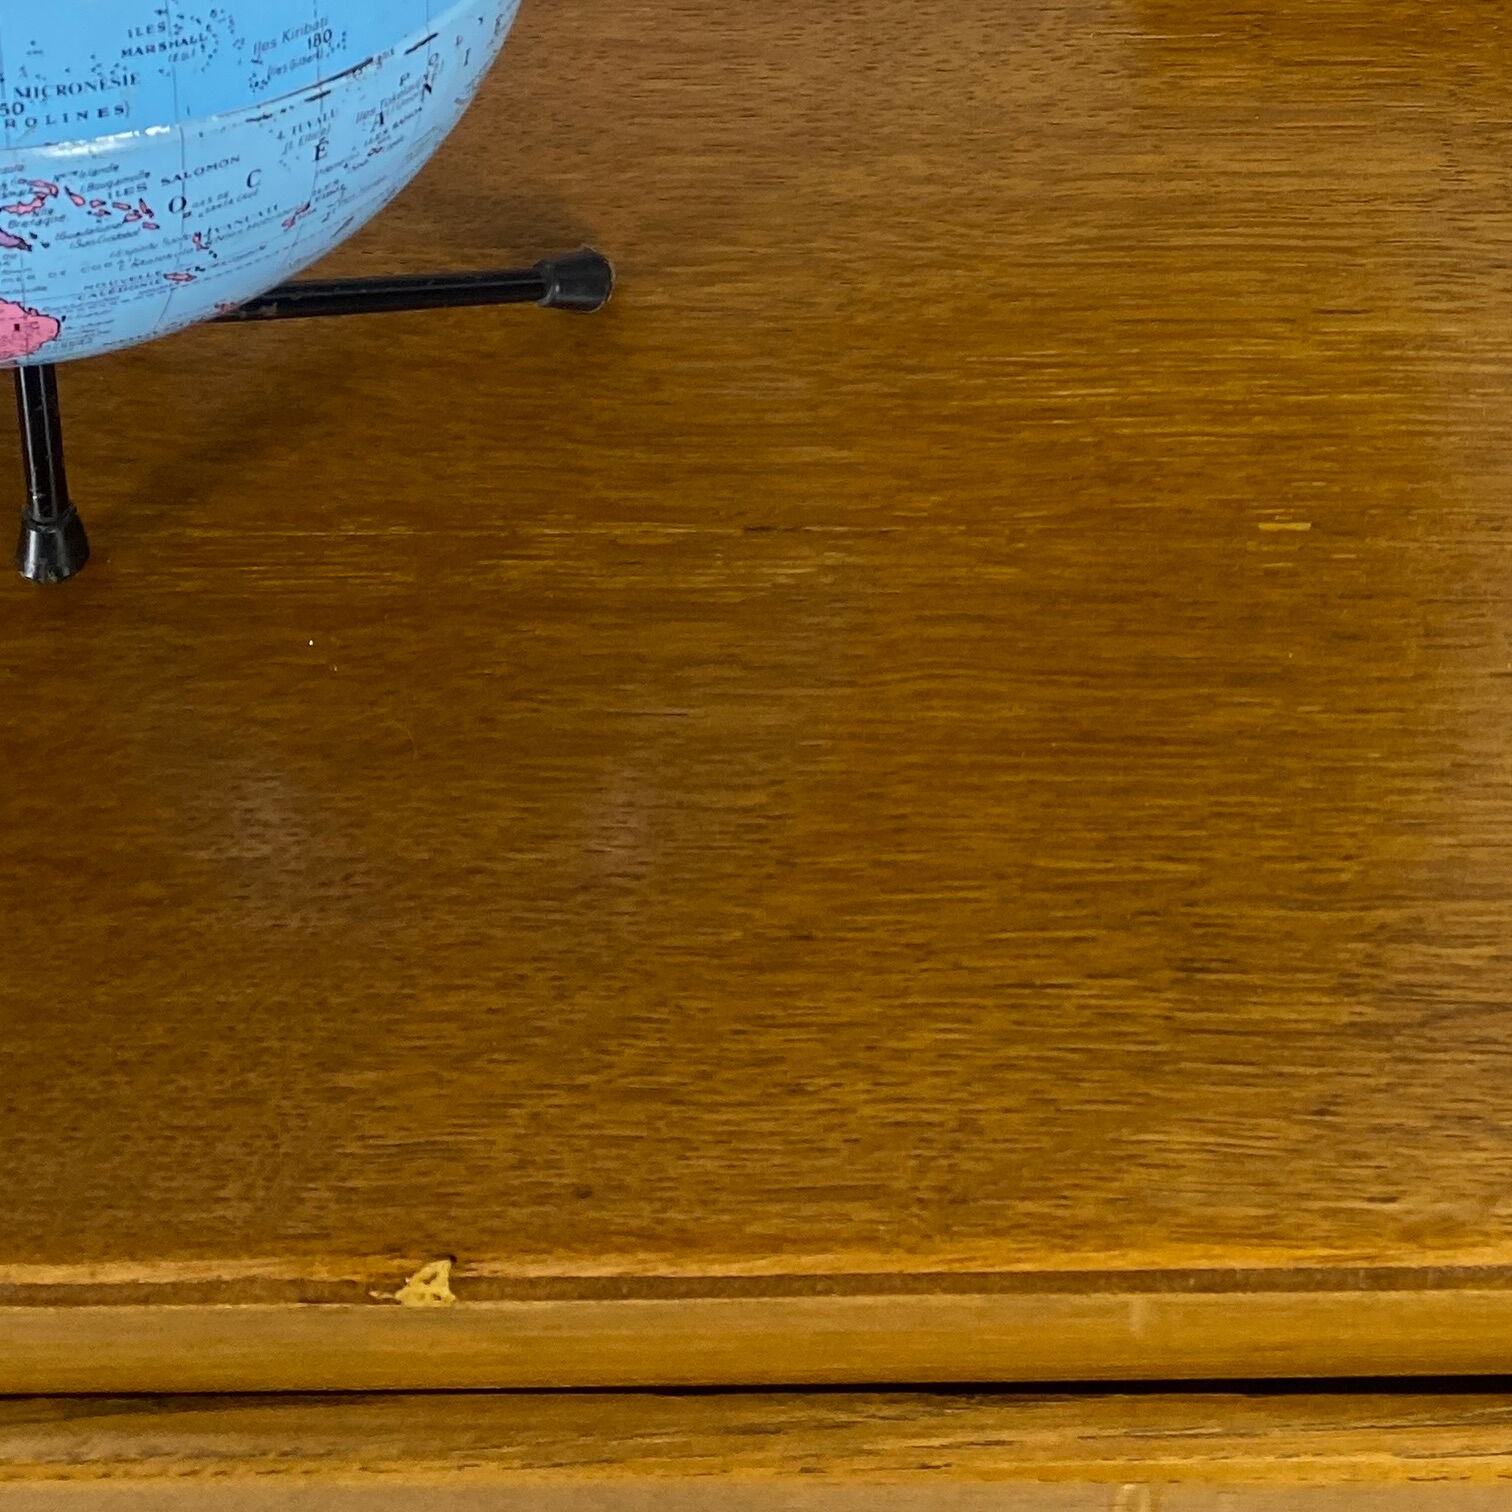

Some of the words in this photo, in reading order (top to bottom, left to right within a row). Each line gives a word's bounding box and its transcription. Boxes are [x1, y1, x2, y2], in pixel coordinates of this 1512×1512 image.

[127, 21, 167, 39] ILES
[307, 29, 333, 50] 180
[120, 33, 209, 58] MARSHALL
[160, 154, 241, 186] SALOMON
